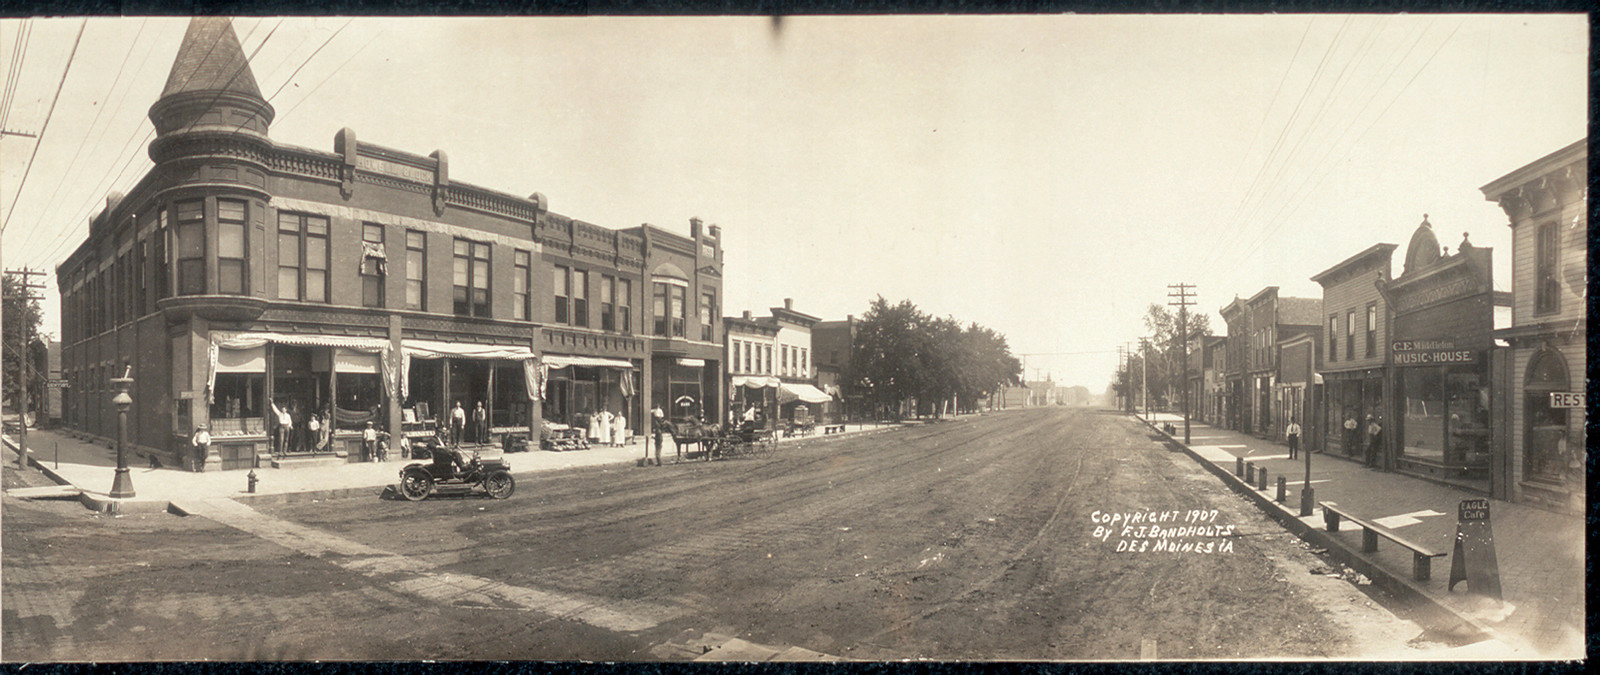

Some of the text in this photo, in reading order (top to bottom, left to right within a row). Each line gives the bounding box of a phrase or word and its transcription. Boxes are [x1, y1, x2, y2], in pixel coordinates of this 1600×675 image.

[402, 166, 433, 184] BLOCK
[1394, 353, 1428, 363] MUSIC
[1461, 501, 1488, 510] EAGLE
